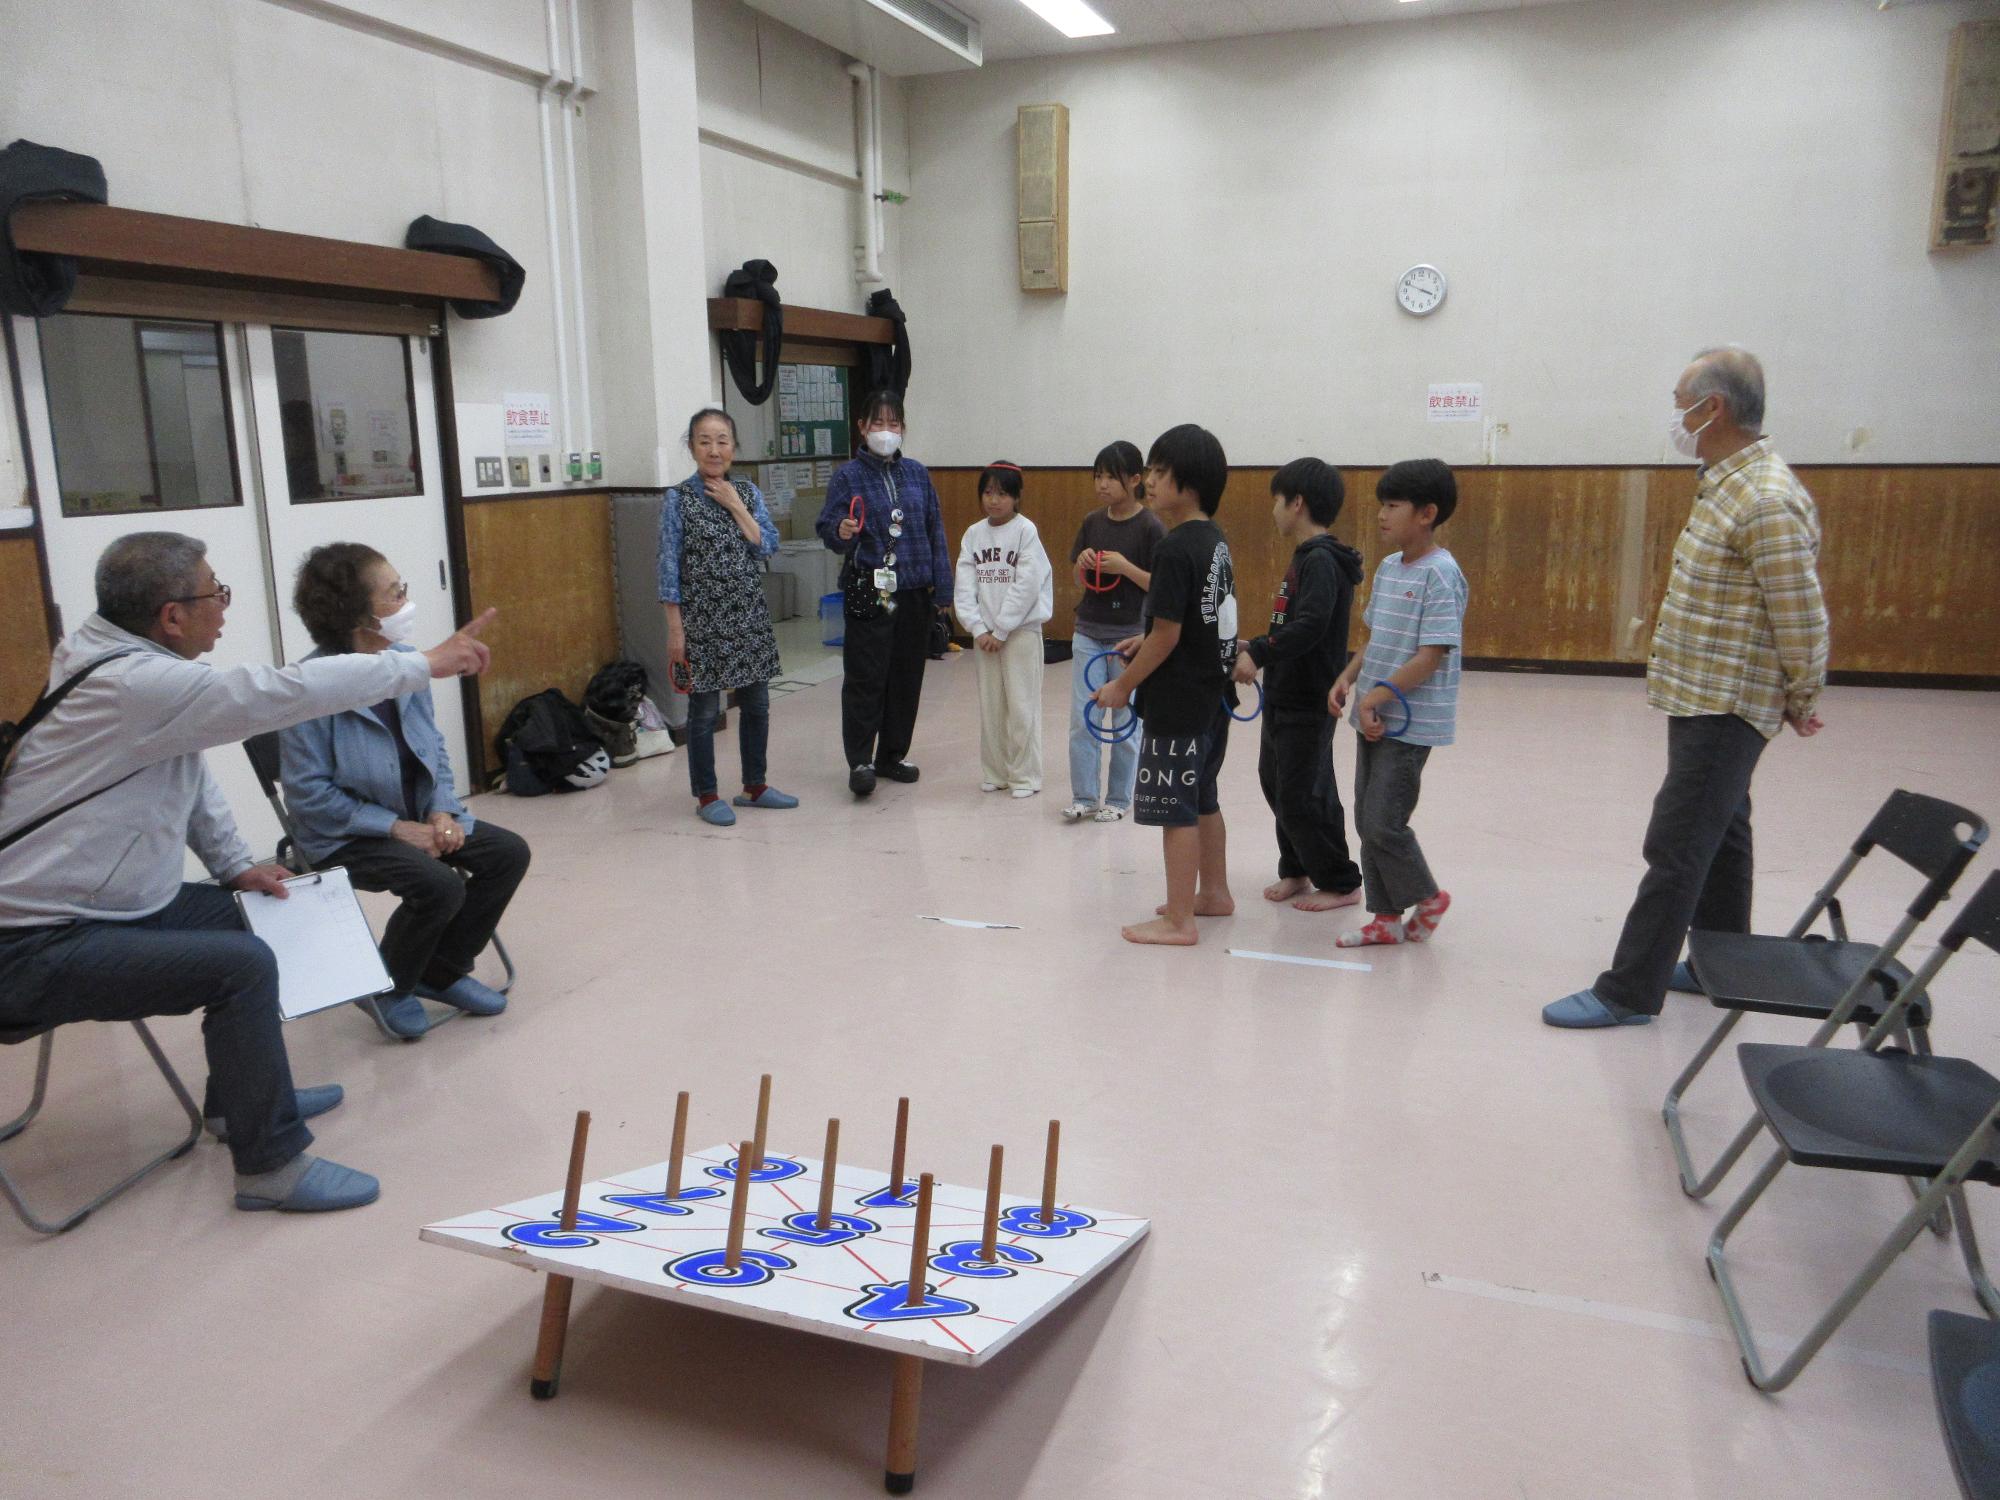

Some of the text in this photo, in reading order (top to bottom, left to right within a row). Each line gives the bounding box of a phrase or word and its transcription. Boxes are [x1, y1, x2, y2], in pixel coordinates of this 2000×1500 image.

[506, 409, 550, 426] 飲食禁止
[1429, 395, 1480, 408] 飲食禁止
[973, 547, 1001, 565] AME
[1200, 545, 1222, 624] FULLCO
[1142, 738, 1197, 756] ILLA
[1139, 768, 1196, 787] ONG
[500, 1208, 648, 1248] 2
[756, 1210, 882, 1247] 5
[997, 1204, 1097, 1239] 8
[926, 1239, 1044, 1279] 3
[842, 1279, 980, 1323] 4
